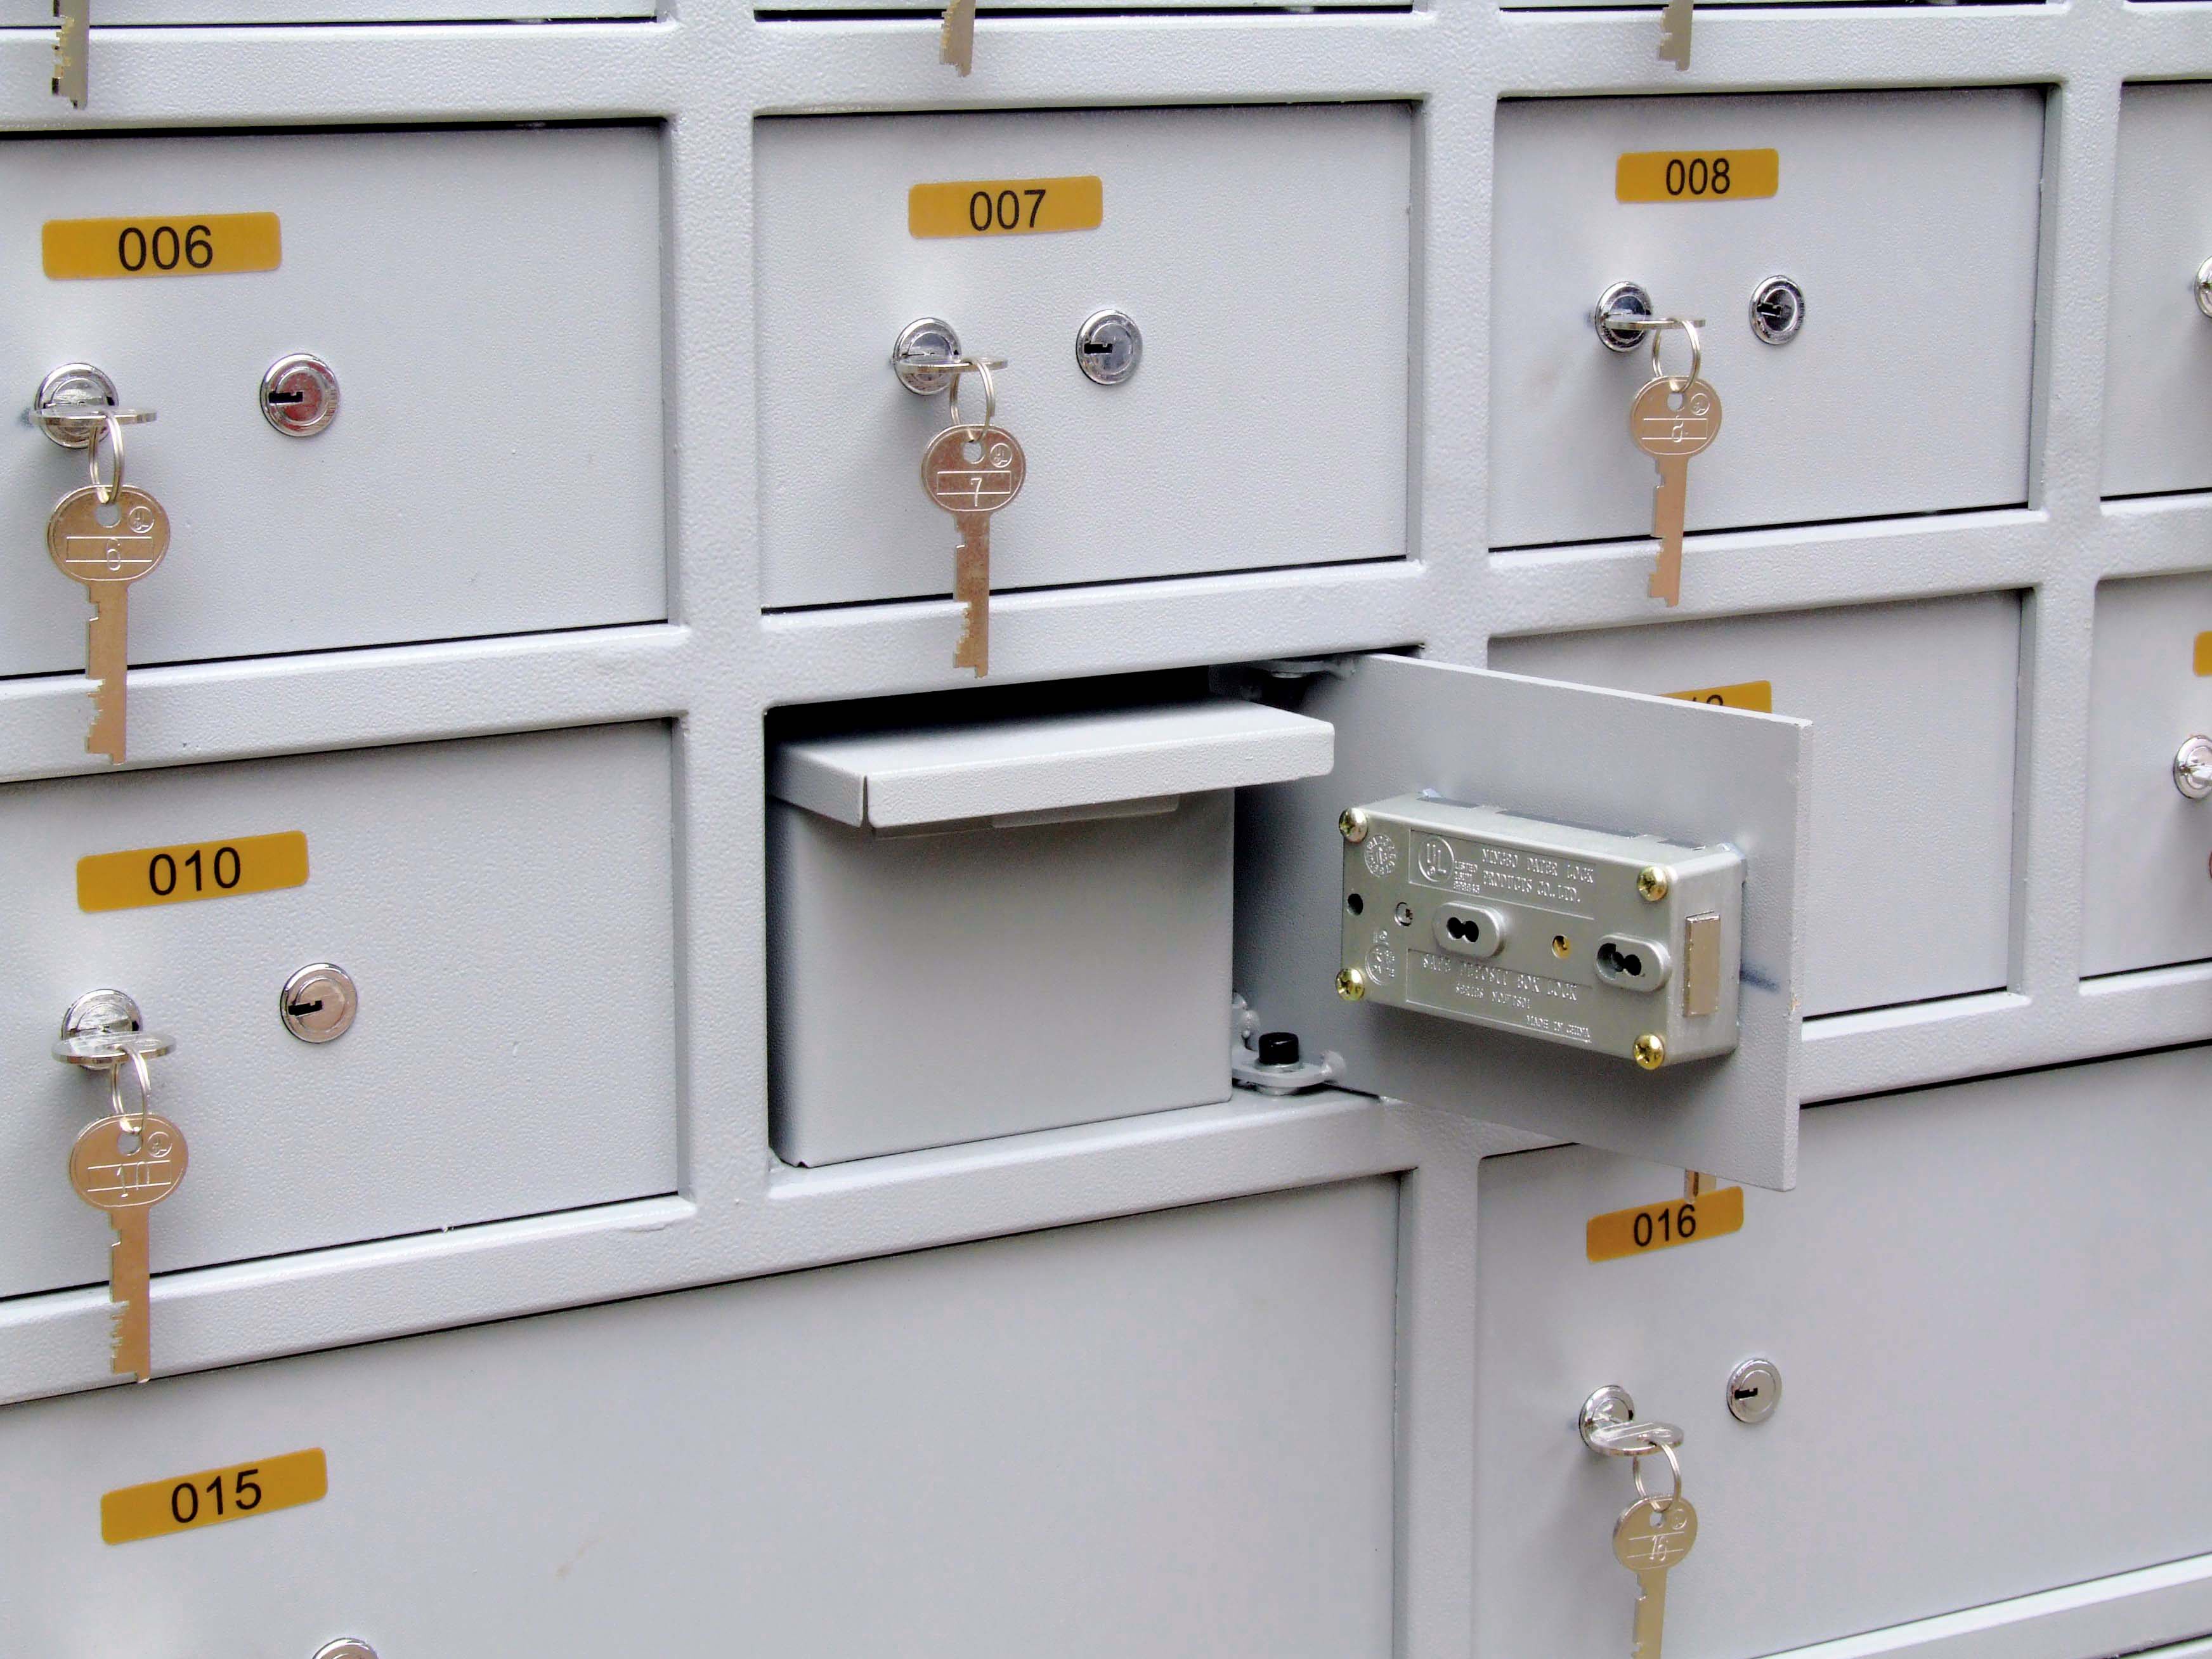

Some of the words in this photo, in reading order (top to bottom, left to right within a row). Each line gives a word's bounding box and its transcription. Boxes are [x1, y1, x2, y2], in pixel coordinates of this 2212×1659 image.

[1666, 157, 1731, 196] 008
[969, 188, 1047, 231] 007
[118, 224, 214, 271] 006
[970, 477, 982, 507] 7
[105, 537, 122, 571] 6
[148, 846, 242, 896] 010
[1566, 864, 1594, 883] LOCK
[1633, 1204, 1696, 1248] 016
[171, 1468, 262, 1523] 015
